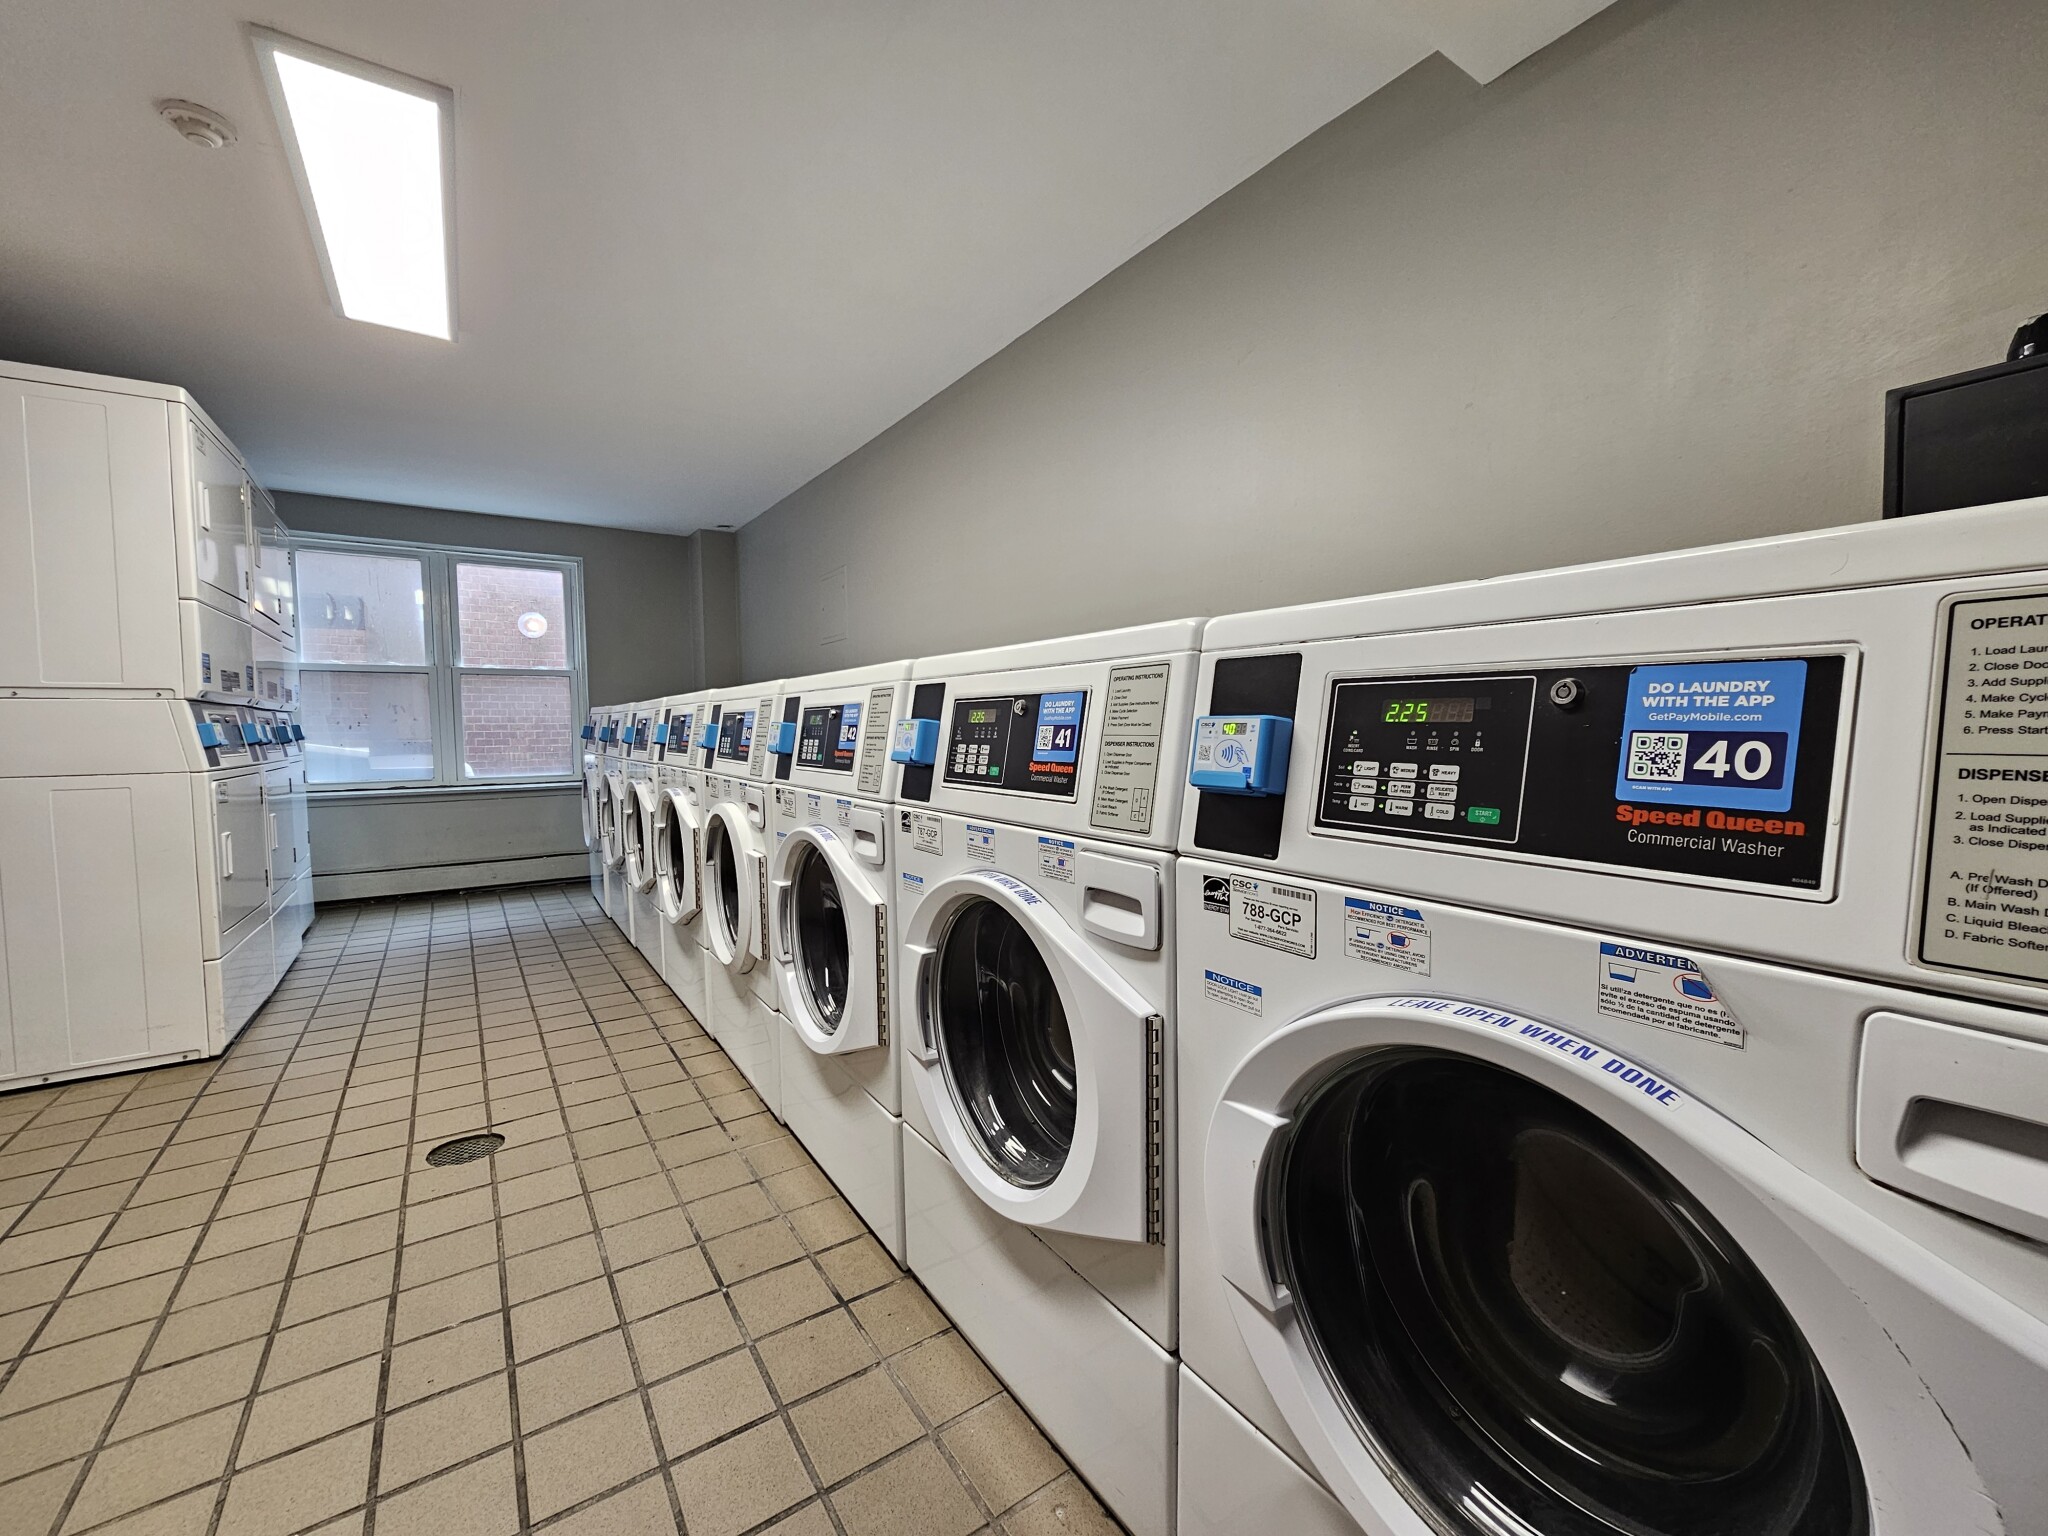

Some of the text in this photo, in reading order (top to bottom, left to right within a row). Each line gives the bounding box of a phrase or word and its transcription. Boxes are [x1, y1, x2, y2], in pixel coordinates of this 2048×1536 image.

[1985, 646, 2016, 655] Load
[1984, 662, 2019, 671] Close
[1649, 681, 1771, 694] DO LAUNDRY
[1968, 679, 1978, 687] 3.
[1981, 678, 2006, 686] Add
[1642, 695, 1775, 707] WITH THE APP
[1981, 694, 2015, 702] Make
[1386, 703, 1427, 722] 2.25
[1649, 713, 1762, 722] GetPayMobile.com
[1965, 710, 1975, 718] 5.
[1980, 710, 2013, 718] Make
[847, 726, 856, 740] 42
[1964, 726, 2048, 734] 6. Press Start
[1055, 729, 1071, 747] 41
[1029, 762, 1073, 773] Speed Queen
[1693, 740, 1772, 781] 40
[1958, 794, 2048, 807] 1. Open Dispe
[1616, 804, 1805, 836] Speed Queen
[1955, 811, 1966, 820] 2.
[1971, 812, 2001, 822] Load
[1989, 824, 2046, 836] Indicated
[1628, 829, 1785, 857] Commercial Washer
[1953, 836, 1964, 844] 3.
[1969, 836, 2004, 847] Close
[1232, 879, 1252, 889] CSC
[1950, 871, 1963, 880] A.
[1968, 873, 1989, 882] Pre
[1995, 876, 2033, 886] Wash
[1966, 884, 2038, 900] (If Offered)
[1243, 901, 1301, 926] 788-GCP
[1369, 903, 1404, 915] NOTICE
[1948, 898, 1960, 907] B.
[1965, 899, 1996, 911] Main
[2001, 903, 2039, 916] Wash
[1348, 915, 1376, 923] RECOMMENDED
[1397, 924, 1427, 935] PERFORMANCE
[1395, 919, 1419, 927] DETERGENT
[1946, 914, 2048, 934] C. Liquid Bleac
[1945, 929, 1958, 939] D.
[1963, 932, 2004, 945] Fabric
[1213, 974, 1254, 993] NOTICE
[1601, 983, 1609, 991] Si
[1634, 992, 1675, 1006] detergente
[1677, 1002, 1692, 1010] que
[1601, 991, 1618, 1000] evite
[1628, 997, 1654, 1007] exceso
[1657, 1003, 1667, 1011] de
[1669, 1007, 1701, 1018] espuma
[1704, 1014, 1736, 1027] usando
[1600, 1005, 1650, 1020] recomendada
[1652, 1017, 1666, 1026] por
[1677, 1023, 1721, 1038] fabricante.
[1601, 998, 1616, 1006] sólo
[1646, 1008, 1680, 1022] cantidad
[1695, 1019, 1740, 1036] detergente
[1390, 998, 1680, 1107] LEAVE OPEN WHEN DONE
